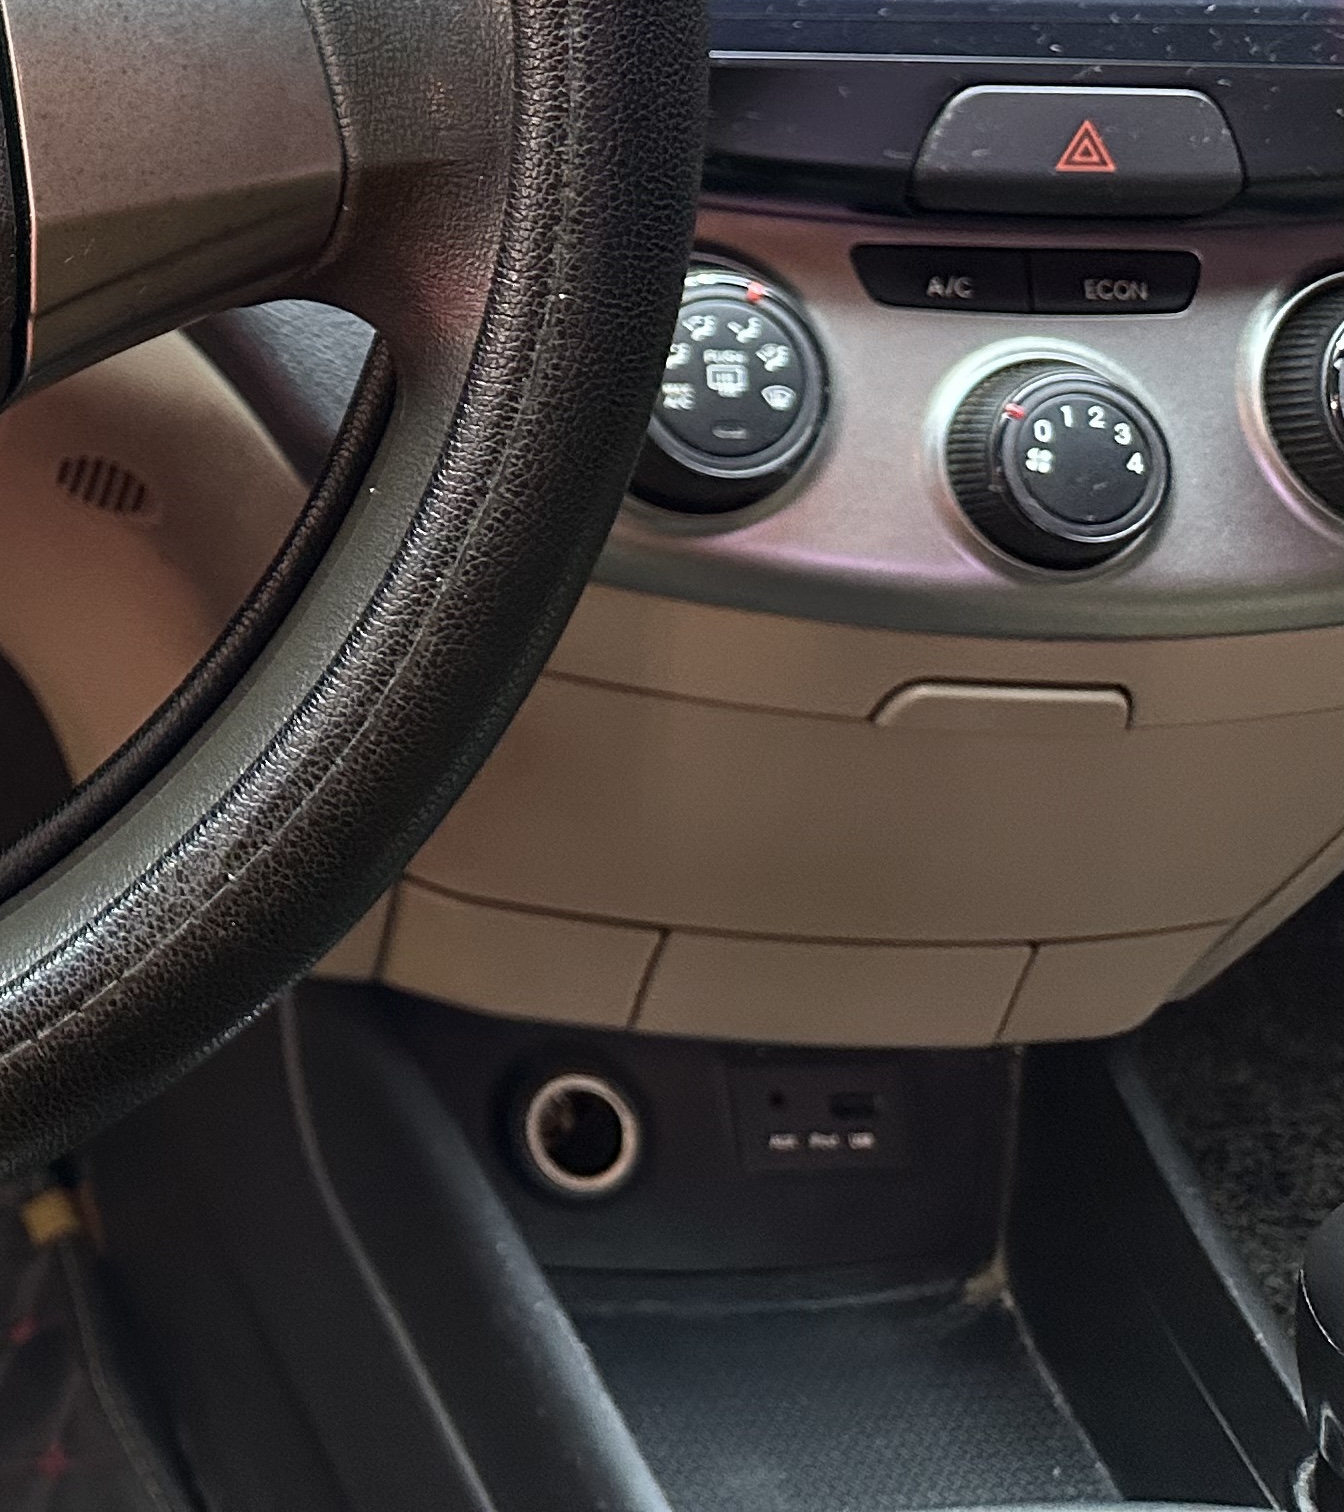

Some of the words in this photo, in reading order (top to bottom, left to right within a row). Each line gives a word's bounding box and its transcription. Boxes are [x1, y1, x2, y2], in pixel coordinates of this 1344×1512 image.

[926, 275, 972, 300] A/C
[1083, 279, 1148, 302] ECON
[1033, 418, 1055, 443] 0
[1059, 404, 1073, 428] 1
[1088, 404, 1106, 428] 2
[1114, 422, 1132, 445] 3
[1125, 452, 1145, 475] 4
